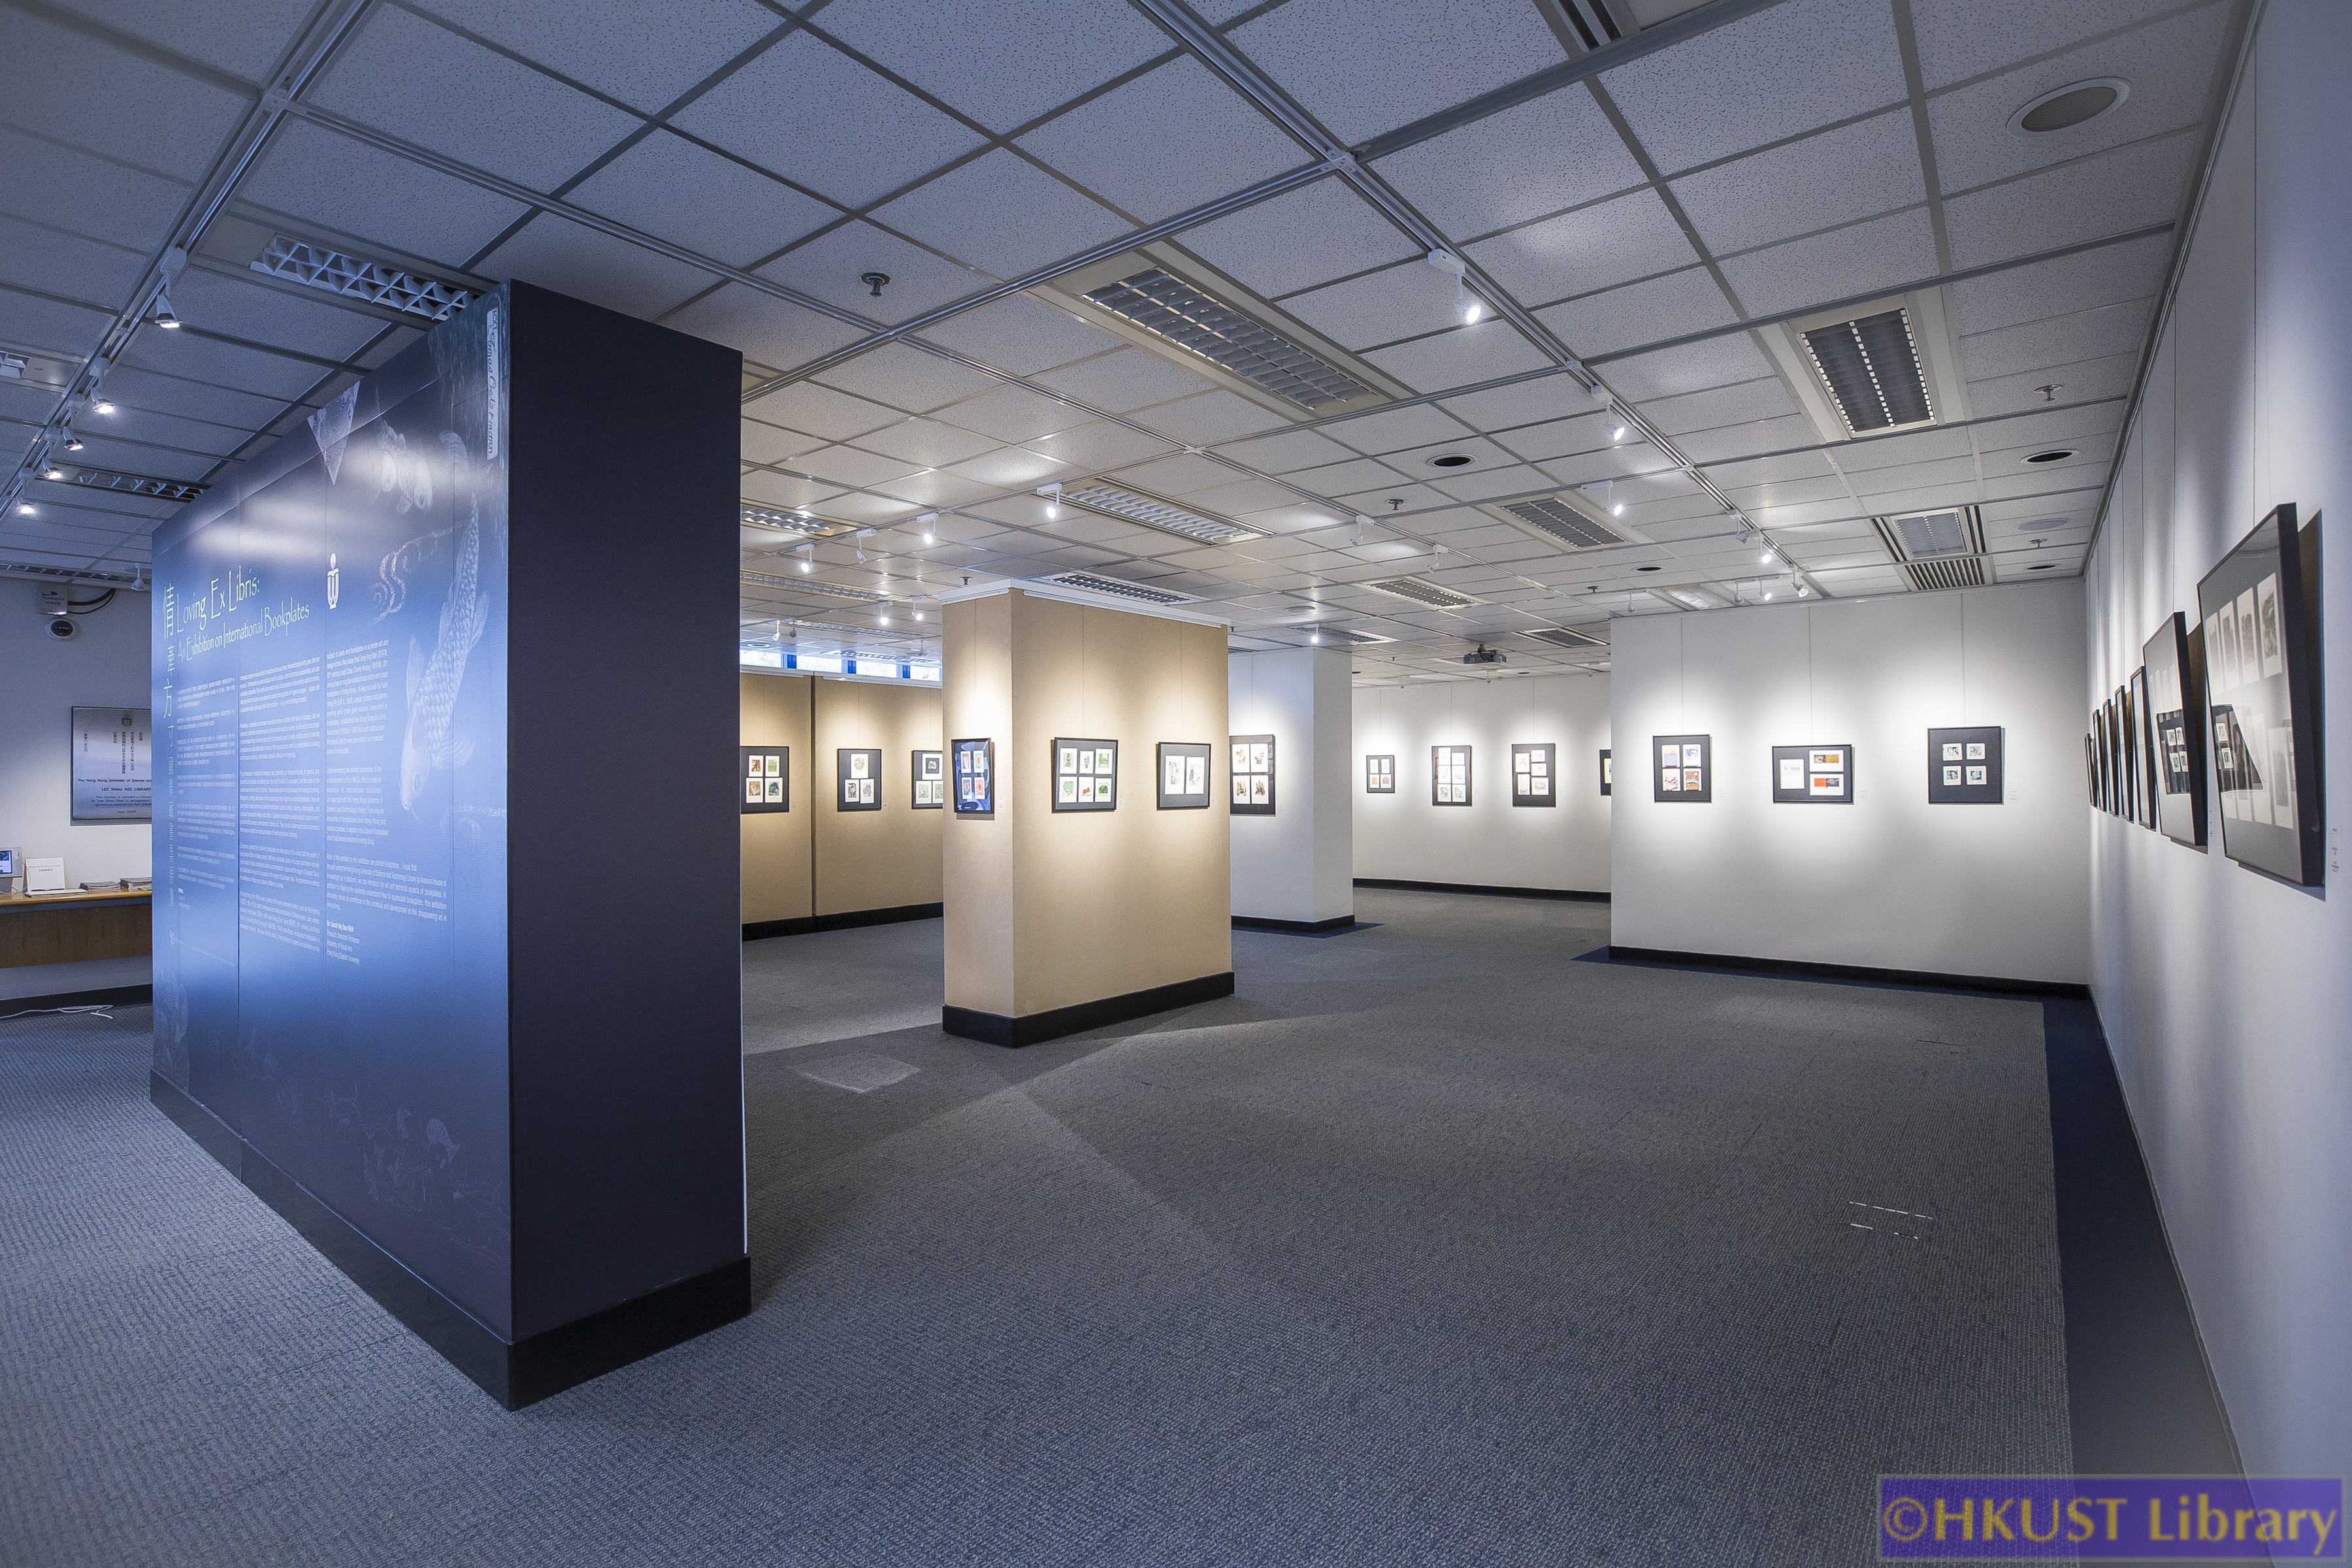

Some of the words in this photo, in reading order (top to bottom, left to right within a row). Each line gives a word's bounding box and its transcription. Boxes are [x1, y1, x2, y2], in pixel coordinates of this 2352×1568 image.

[177, 592, 207, 633] Loving
[210, 578, 226, 619] Ex
[228, 564, 260, 612] Libris:
[177, 640, 186, 663] An
[186, 632, 214, 661] Exhibition
[215, 637, 223, 648] on
[223, 608, 263, 649] International
[264, 596, 310, 637] Bookplates
